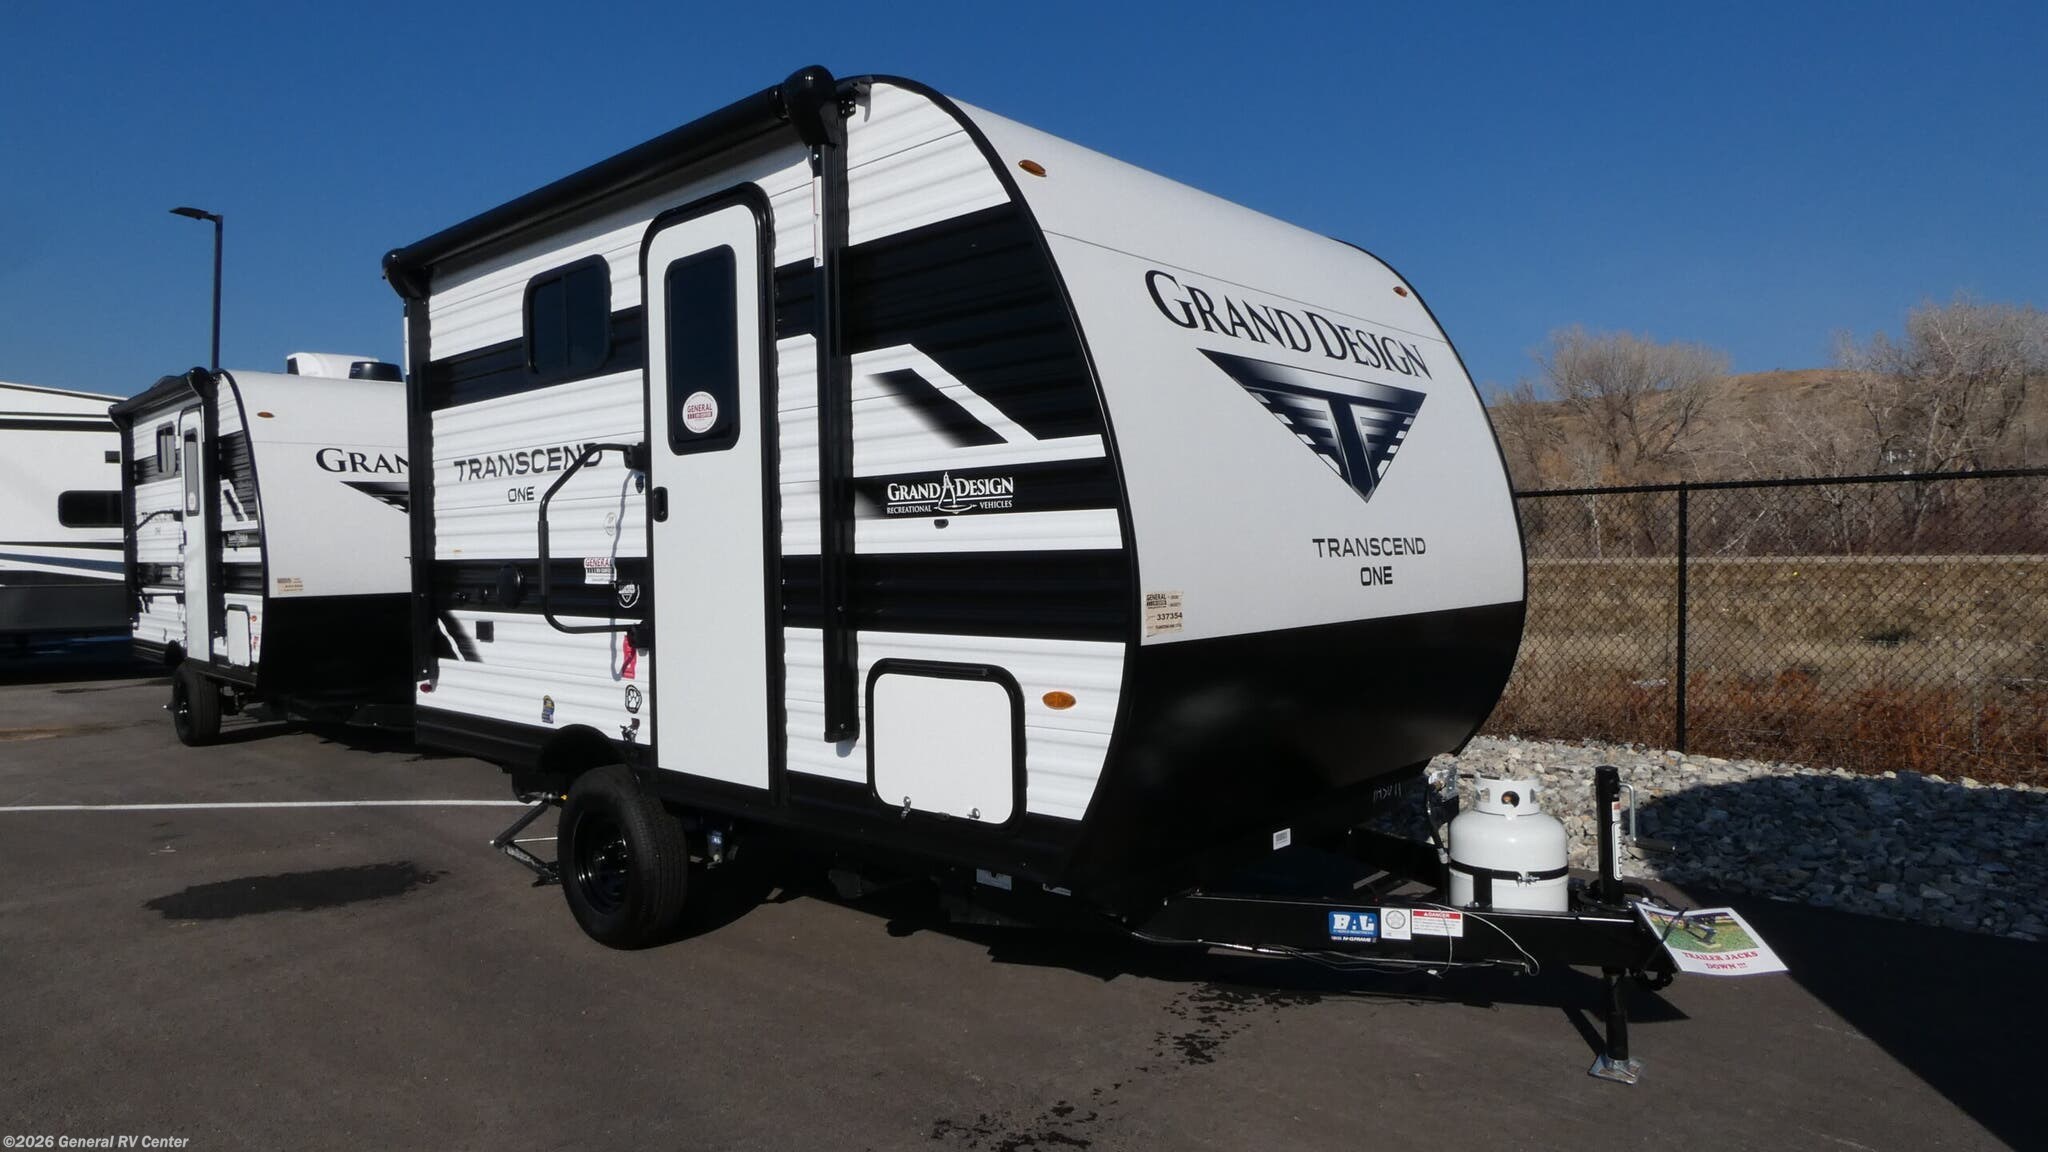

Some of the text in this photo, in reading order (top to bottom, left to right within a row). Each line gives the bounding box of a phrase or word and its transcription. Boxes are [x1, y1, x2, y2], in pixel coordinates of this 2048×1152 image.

[1144, 269, 1433, 381] GRAND DESIGN
[453, 442, 603, 482] TRANSCEND
[507, 486, 536, 503] ONE
[887, 477, 1014, 501] GRAND DESIGN
[886, 500, 1013, 514] RECREATIONAL VEHICLES
[1311, 537, 1427, 558] TRANSCEND
[1360, 566, 1394, 587] ONE
[1681, 950, 1759, 961] TRAILER JACKS
[1705, 962, 1736, 970] DOWN
